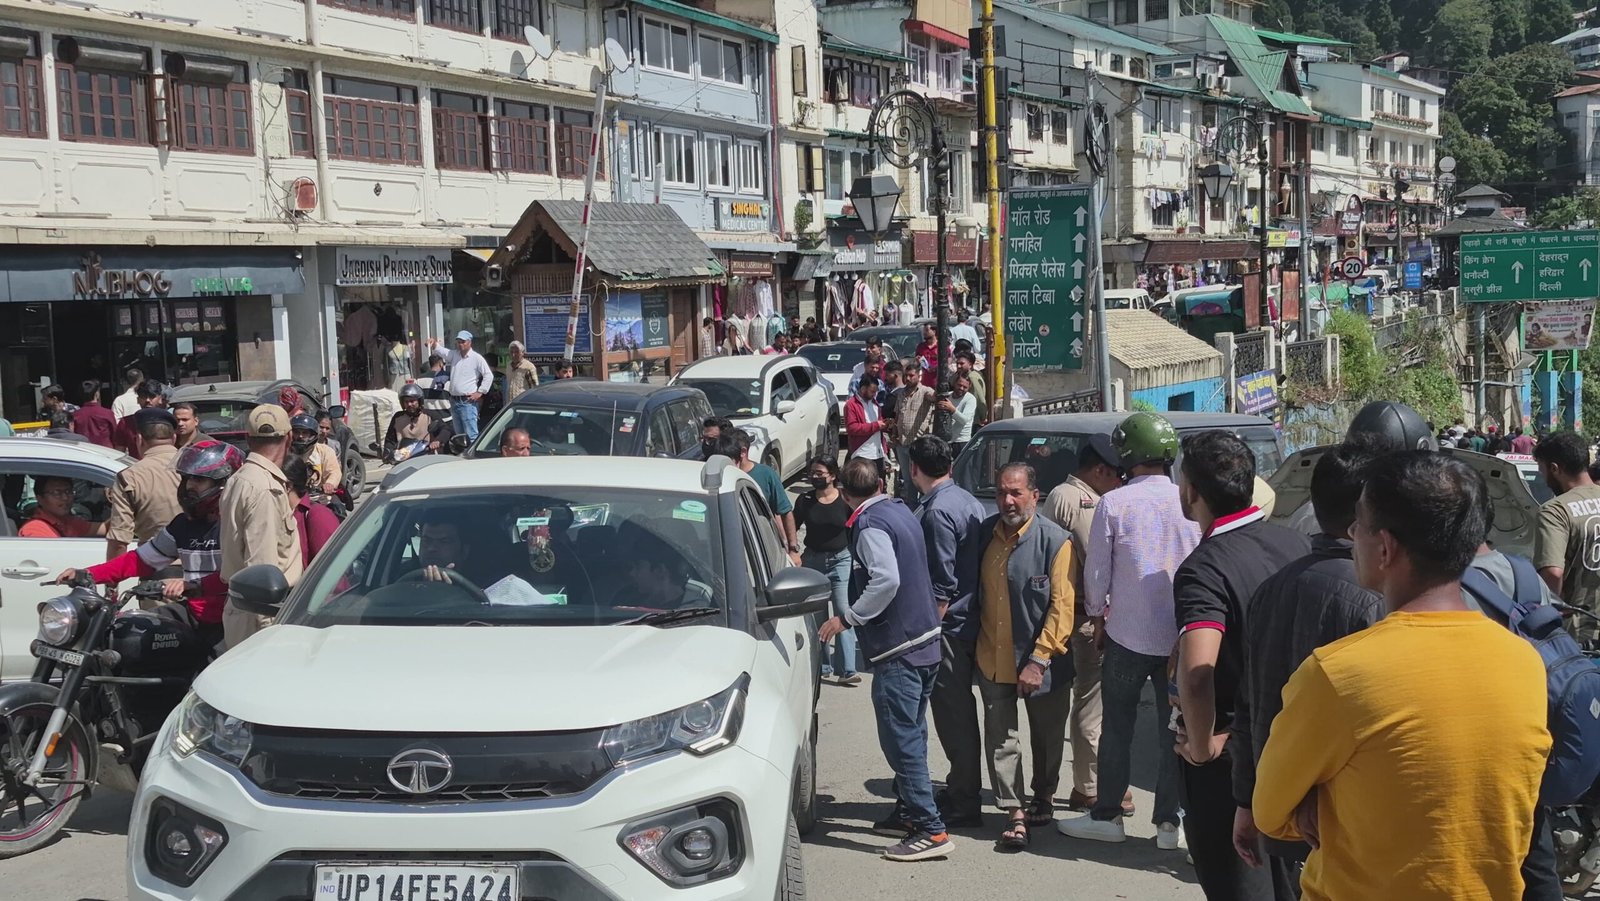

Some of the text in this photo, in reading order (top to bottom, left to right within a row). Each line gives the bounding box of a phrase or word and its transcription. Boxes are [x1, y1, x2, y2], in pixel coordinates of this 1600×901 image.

[732, 203, 761, 215] SINGHAL
[1011, 204, 1051, 226] मॉल रोड
[722, 219, 767, 230] MEDICAL CENTRE
[1010, 231, 1042, 253] गनहिल
[1463, 255, 1479, 265] किंग
[1539, 251, 1569, 264] देहरादून
[342, 255, 453, 278] JAGDISH PRASAD & SONS
[1009, 257, 1065, 279] पिक्चर पैलेस
[1346, 262, 1360, 273] 20
[1539, 266, 1565, 277] हरिद्वार
[1486, 283, 1503, 294] झील
[1539, 280, 1562, 291] दिल्ली
[1008, 284, 1055, 305] लाल टिब्बा
[1012, 337, 1041, 358] नोल्टी
[152, 640, 180, 650] ENFIELD
[320, 885, 335, 893] IND
[337, 874, 512, 901] UP14FE5424
